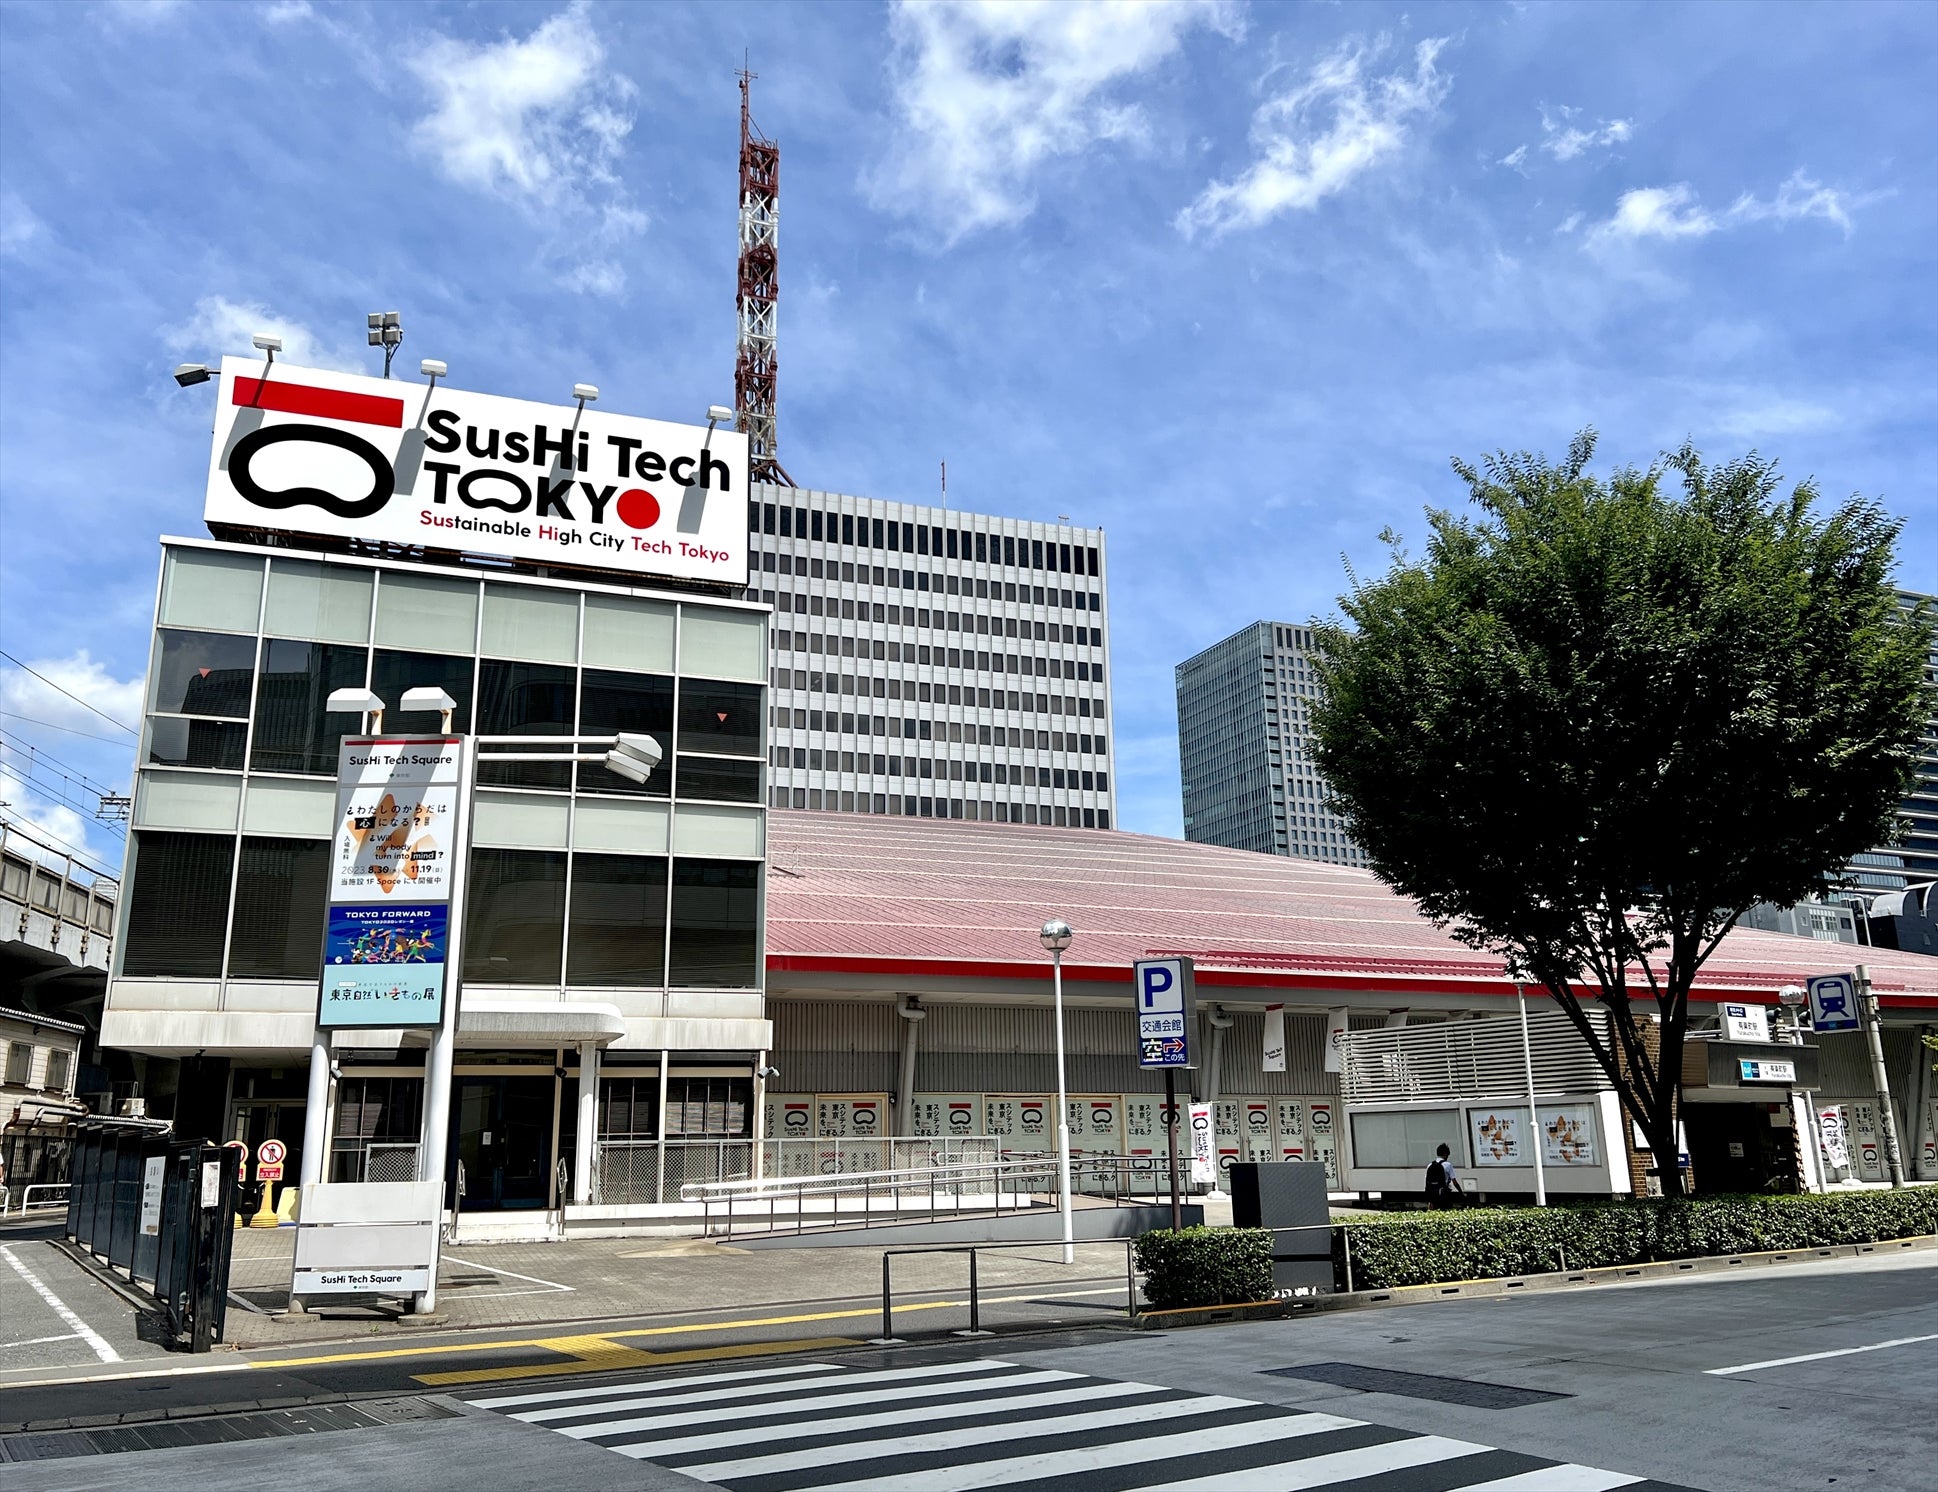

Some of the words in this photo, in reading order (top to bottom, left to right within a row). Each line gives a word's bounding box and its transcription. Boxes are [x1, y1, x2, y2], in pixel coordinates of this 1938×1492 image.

[424, 409, 589, 472] SusHi
[607, 434, 731, 491] Tech
[424, 461, 660, 529] TOKYO
[420, 509, 531, 539] Sustainable
[537, 525, 583, 546] High
[589, 532, 625, 552] City
[631, 536, 672, 555] Tech
[679, 542, 729, 564] Tokyo
[349, 756, 381, 765] SusHi
[384, 756, 409, 765] Tech
[411, 755, 453, 766] Square
[345, 911, 379, 919] TOKYO
[381, 910, 432, 918] FORWARD
[1143, 966, 1173, 1008] P
[1142, 1019, 1182, 1033] 交通会館
[1142, 1039, 1163, 1062] 空
[1165, 1053, 1185, 1062] この先
[321, 1276, 346, 1284] SusHi
[348, 1275, 368, 1283] Tech
[370, 1275, 402, 1284] Square
